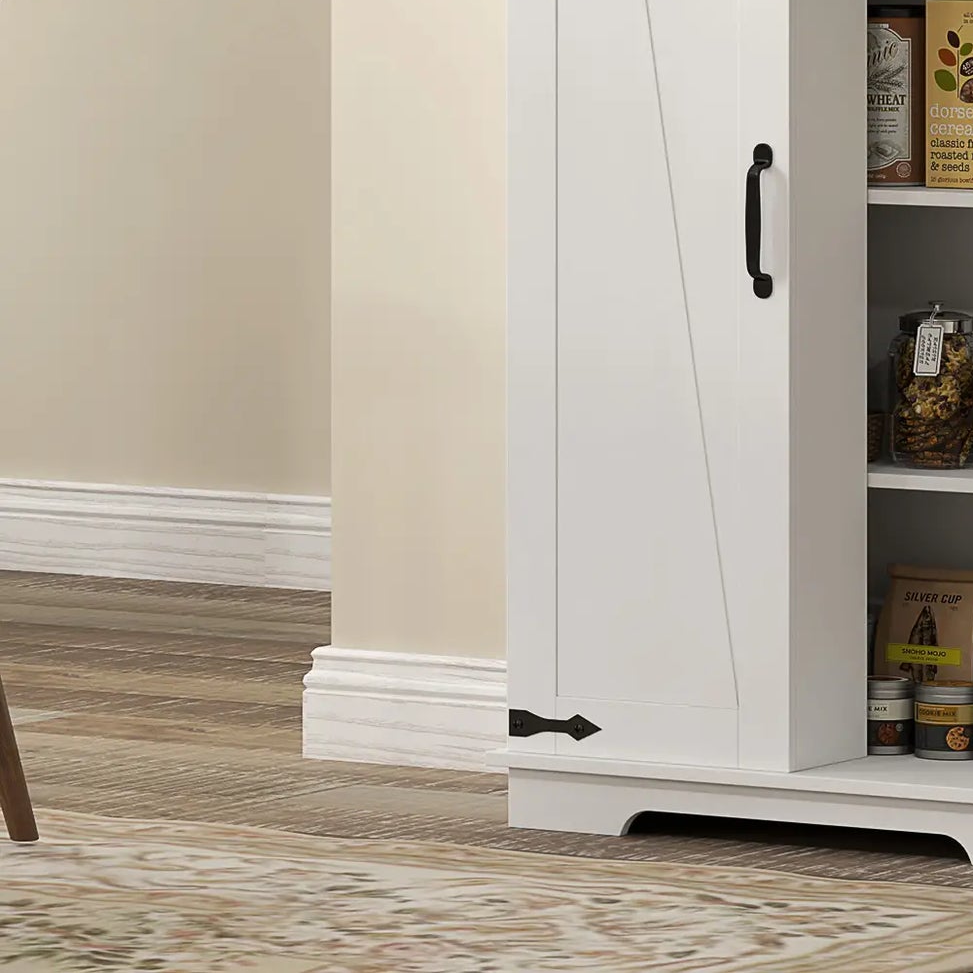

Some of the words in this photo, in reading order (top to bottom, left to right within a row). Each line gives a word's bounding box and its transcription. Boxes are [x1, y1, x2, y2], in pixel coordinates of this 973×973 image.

[930, 137, 965, 149] classic
[930, 150, 969, 160] roasted
[930, 161, 940, 172] &
[941, 162, 970, 173] seeds
[904, 591, 939, 603] SILVER
[940, 594, 963, 604] CUP
[902, 648, 926, 656] SNOHO
[927, 650, 947, 658] MOJO
[919, 708, 941, 717] COOKIE
